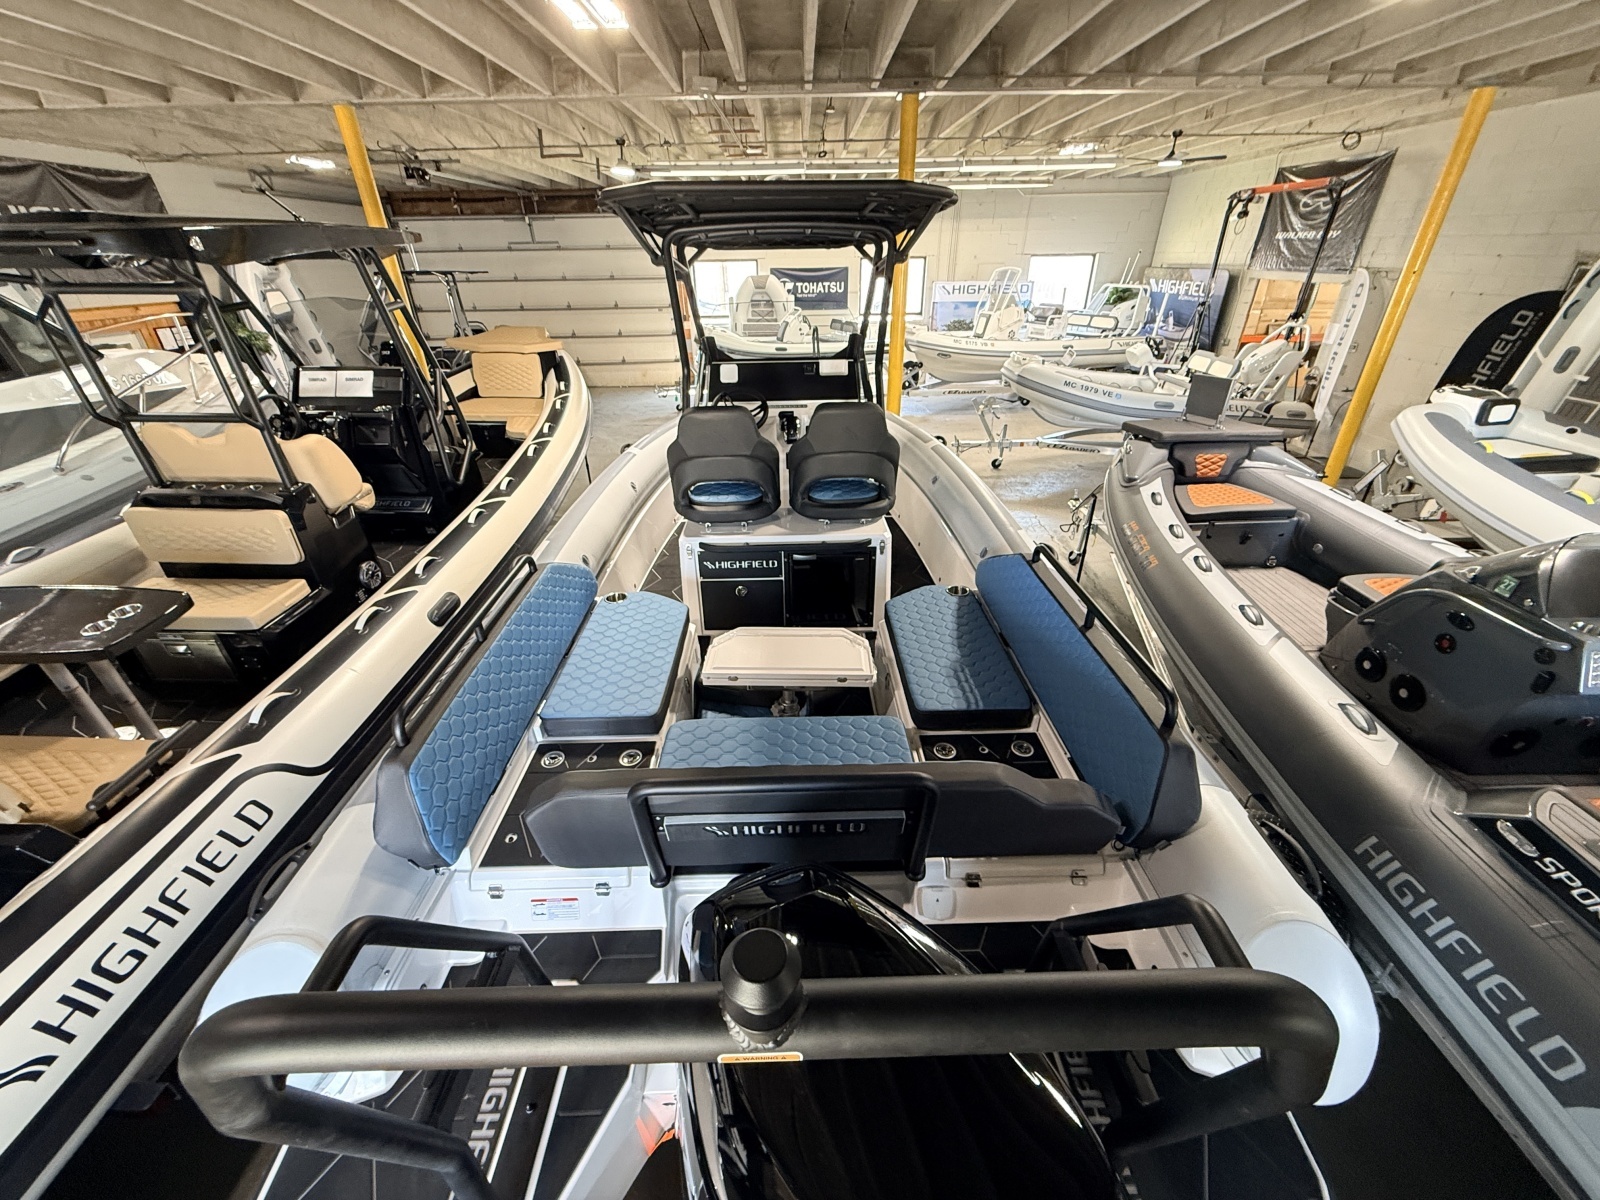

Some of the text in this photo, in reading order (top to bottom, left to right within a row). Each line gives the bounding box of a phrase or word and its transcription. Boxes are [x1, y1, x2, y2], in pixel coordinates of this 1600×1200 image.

[1275, 231, 1318, 240] WALKER
[796, 281, 845, 294] TOHATSU
[1157, 279, 1214, 297] HIGHFIEL
[1063, 380, 1114, 398] MC 1979 VE
[716, 560, 778, 569] HIGHFIELD
[1500, 578, 1516, 591] 27
[31, 799, 274, 1044] HIGHFIELD
[1354, 835, 1587, 1082] HIGHFIELD
